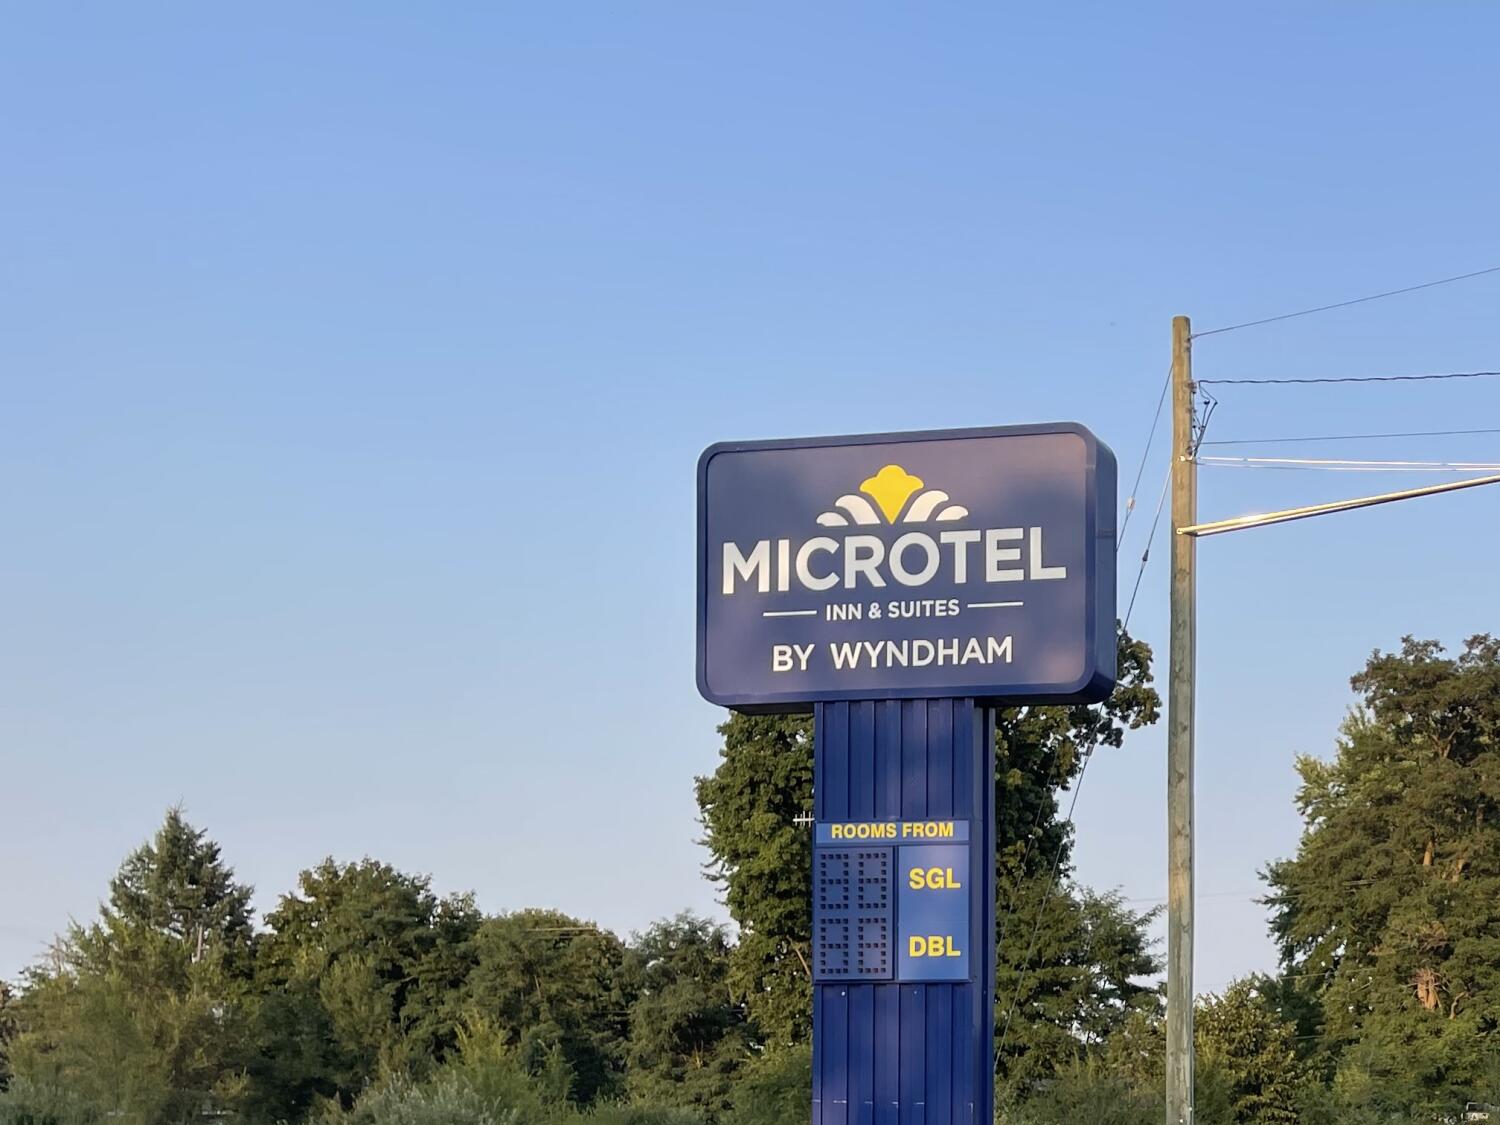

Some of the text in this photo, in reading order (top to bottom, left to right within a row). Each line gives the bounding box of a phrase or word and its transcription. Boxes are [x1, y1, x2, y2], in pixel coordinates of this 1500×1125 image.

[722, 527, 1067, 594] MICROTEL
[826, 599, 960, 621] INN & SUITES
[772, 636, 1013, 672] BY WYNDHAM
[831, 822, 954, 839] ROOMS FROM
[909, 867, 961, 890] SGL
[909, 935, 961, 957] DBL
